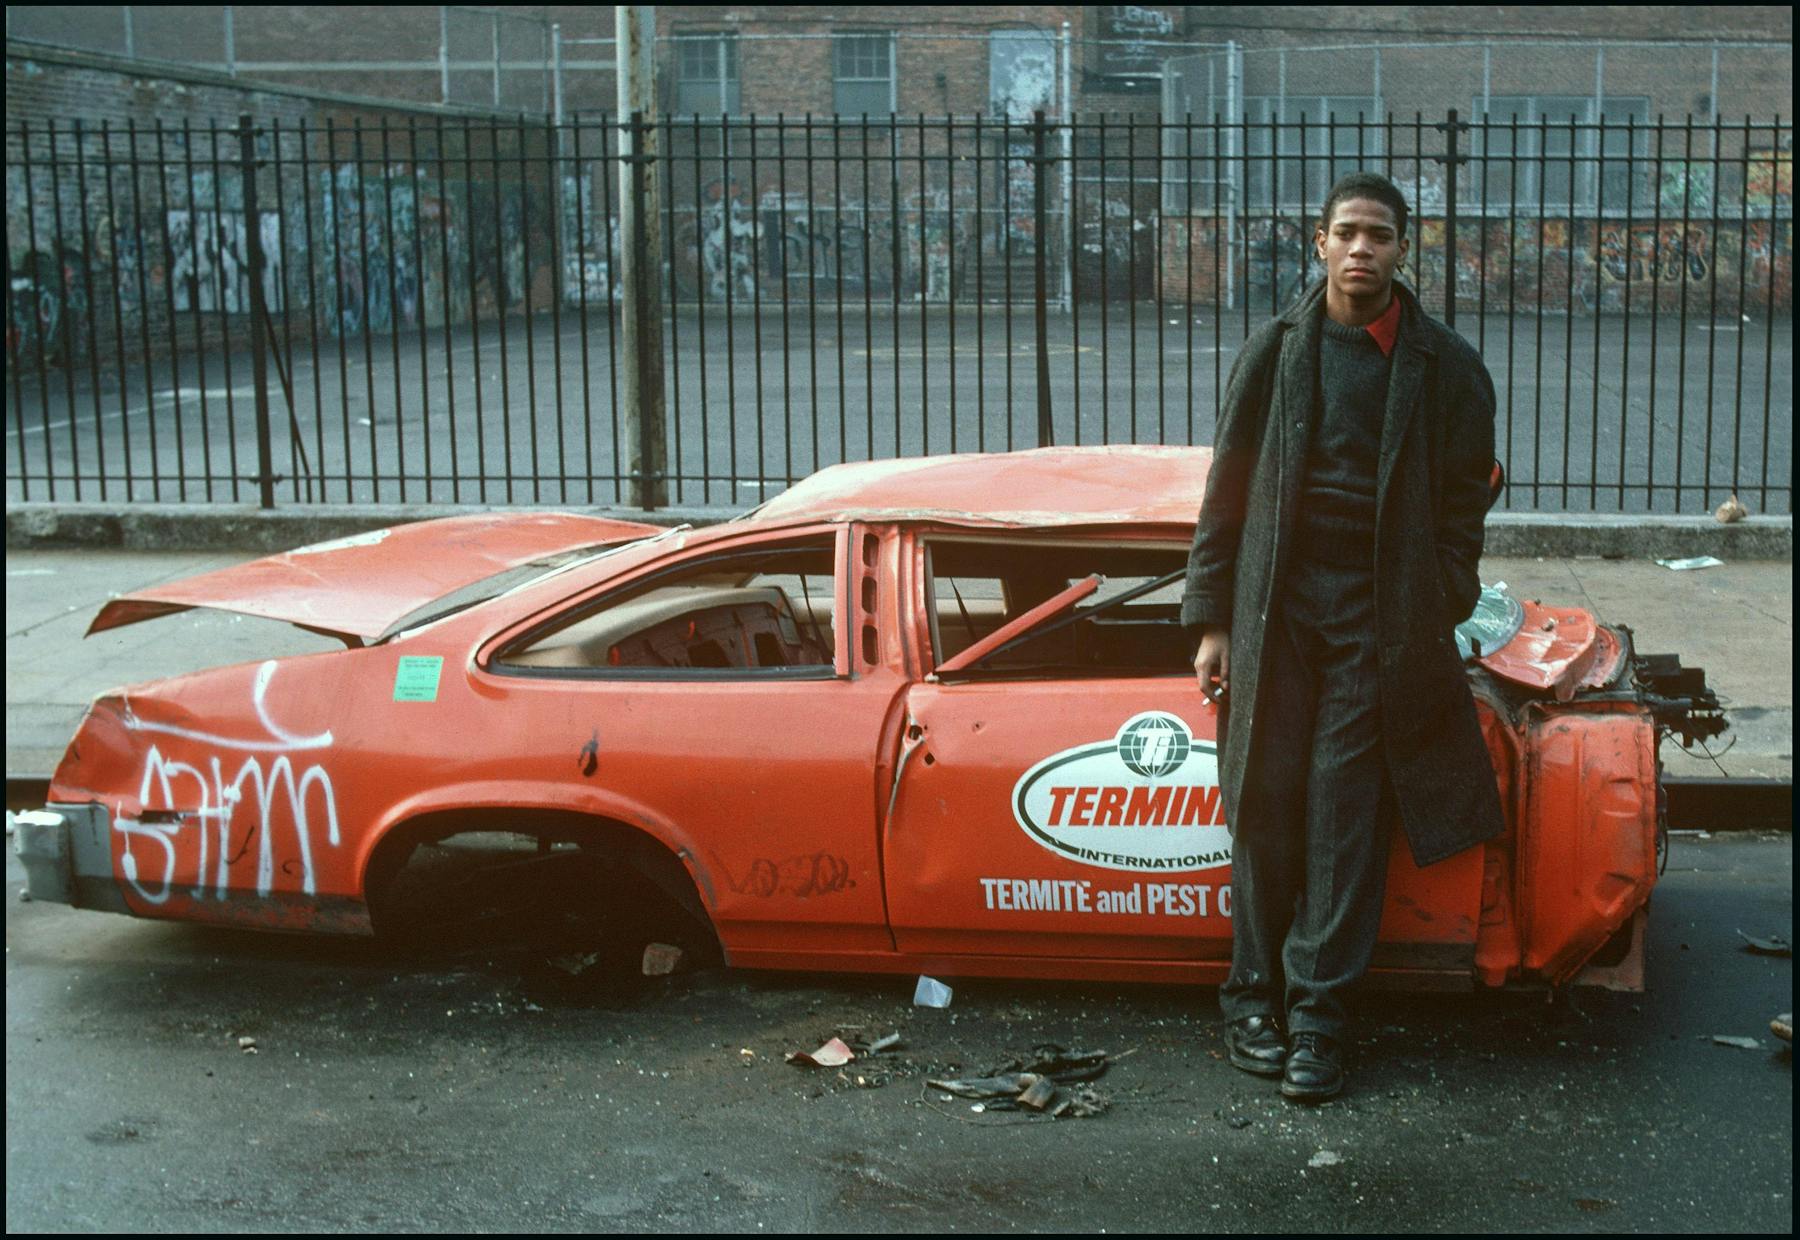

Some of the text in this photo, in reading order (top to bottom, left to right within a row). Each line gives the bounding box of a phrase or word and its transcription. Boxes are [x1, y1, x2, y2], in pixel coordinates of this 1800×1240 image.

[1136, 728, 1173, 766] Ti
[1078, 847, 1232, 869] INTERNATIONAL
[980, 877, 1093, 913] TERMITE
[1096, 883, 1142, 915] and
[1147, 883, 1211, 917] PEST
